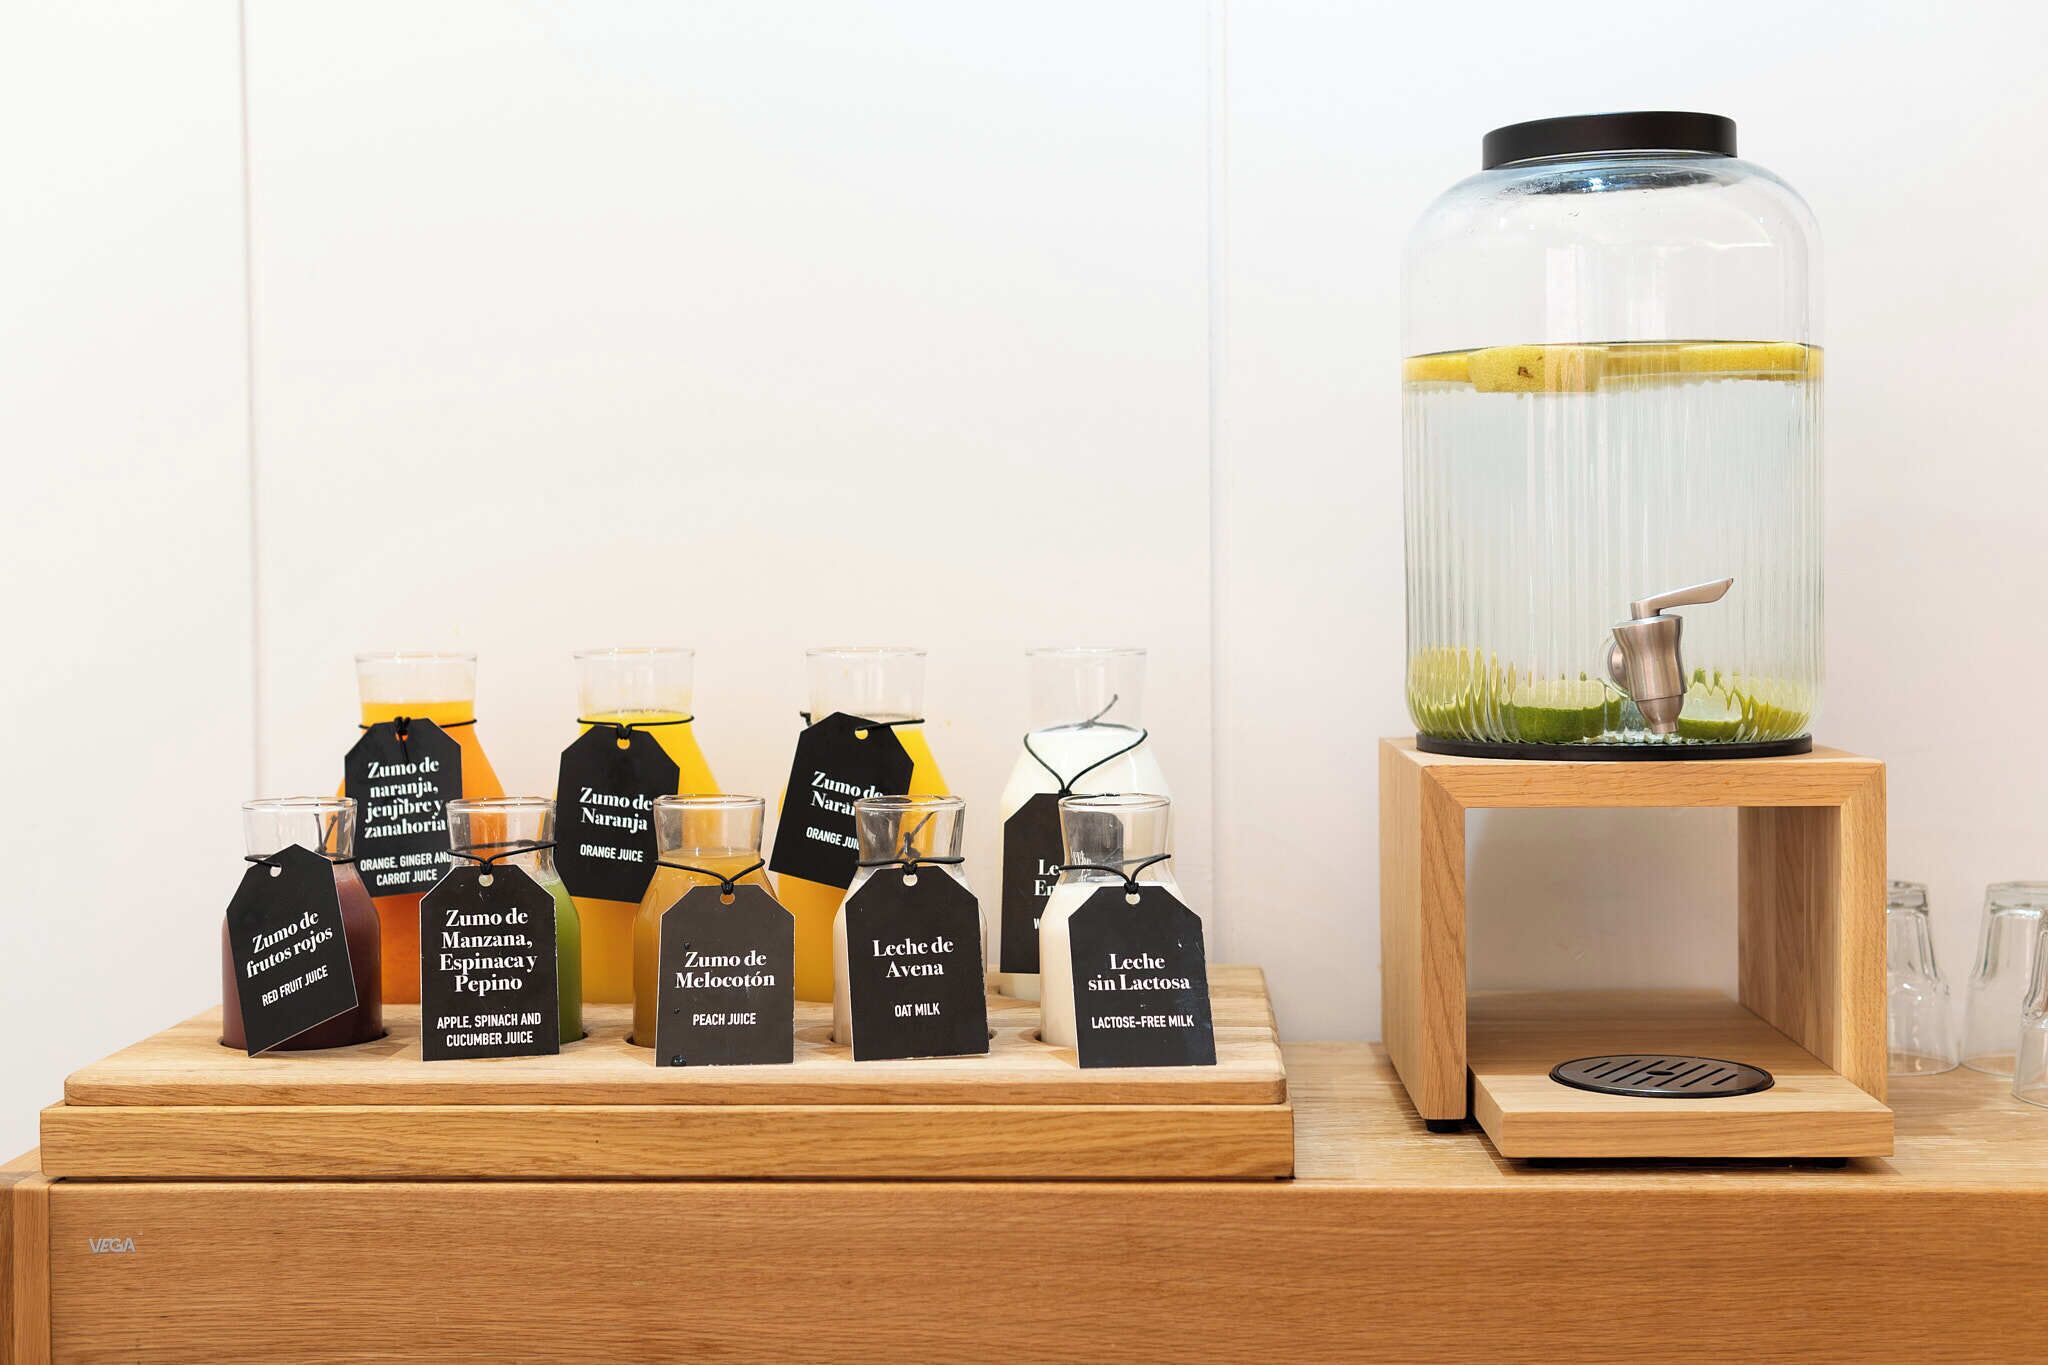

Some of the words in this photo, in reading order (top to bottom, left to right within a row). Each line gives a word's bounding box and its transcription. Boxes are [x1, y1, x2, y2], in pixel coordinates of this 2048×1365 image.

[367, 761, 417, 779] Zumo
[418, 757, 440, 773] de
[370, 777, 439, 798] naranja,
[811, 770, 861, 797] Zumo
[433, 800, 443, 816] y
[579, 786, 630, 808] Zumo
[632, 794, 653, 811] de
[364, 815, 447, 839] zanahoria
[580, 807, 648, 834] Naranja
[806, 826, 843, 846] ORANGE
[399, 853, 433, 868] GINGER
[433, 851, 453, 864] AND
[580, 844, 617, 860] ORANGE
[617, 849, 644, 863] JUICE
[376, 871, 411, 886] CARROT
[412, 868, 438, 883] JUICE
[445, 909, 503, 927] Zumo
[505, 907, 529, 925] de
[252, 923, 297, 954] Zumo
[300, 911, 319, 931] de
[441, 931, 533, 949] Manzana,
[246, 948, 292, 978] frutos
[294, 927, 333, 955] rojos
[872, 938, 928, 957] Leche
[930, 936, 954, 953] de
[439, 952, 524, 976] Espinaca
[525, 955, 538, 973] y
[684, 951, 741, 968] Zumo
[743, 950, 767, 967] de
[1109, 953, 1166, 970] Leche
[885, 961, 944, 978] Avena
[261, 988, 279, 1007] RED
[279, 977, 303, 999] FRUIT
[304, 964, 329, 986] JUICE
[454, 973, 523, 997] Pepino
[674, 970, 776, 989] Melocotón
[1088, 974, 1116, 991] sin
[1119, 974, 1192, 991] Lactosa
[692, 1013, 725, 1026] PEACH
[727, 1012, 757, 1025] JUICE
[894, 1004, 913, 1018] OAT
[915, 1002, 941, 1016] MILK
[436, 1015, 472, 1030] APPLE,
[474, 1013, 518, 1028] SPINACH
[520, 1012, 542, 1026] AND
[1091, 1015, 1167, 1029] LACTOSE-FREE
[1168, 1014, 1195, 1028] MILK
[446, 1032, 502, 1047] CUCUMBER
[504, 1031, 534, 1045] JUICE
[88, 1237, 136, 1253] VEGA
